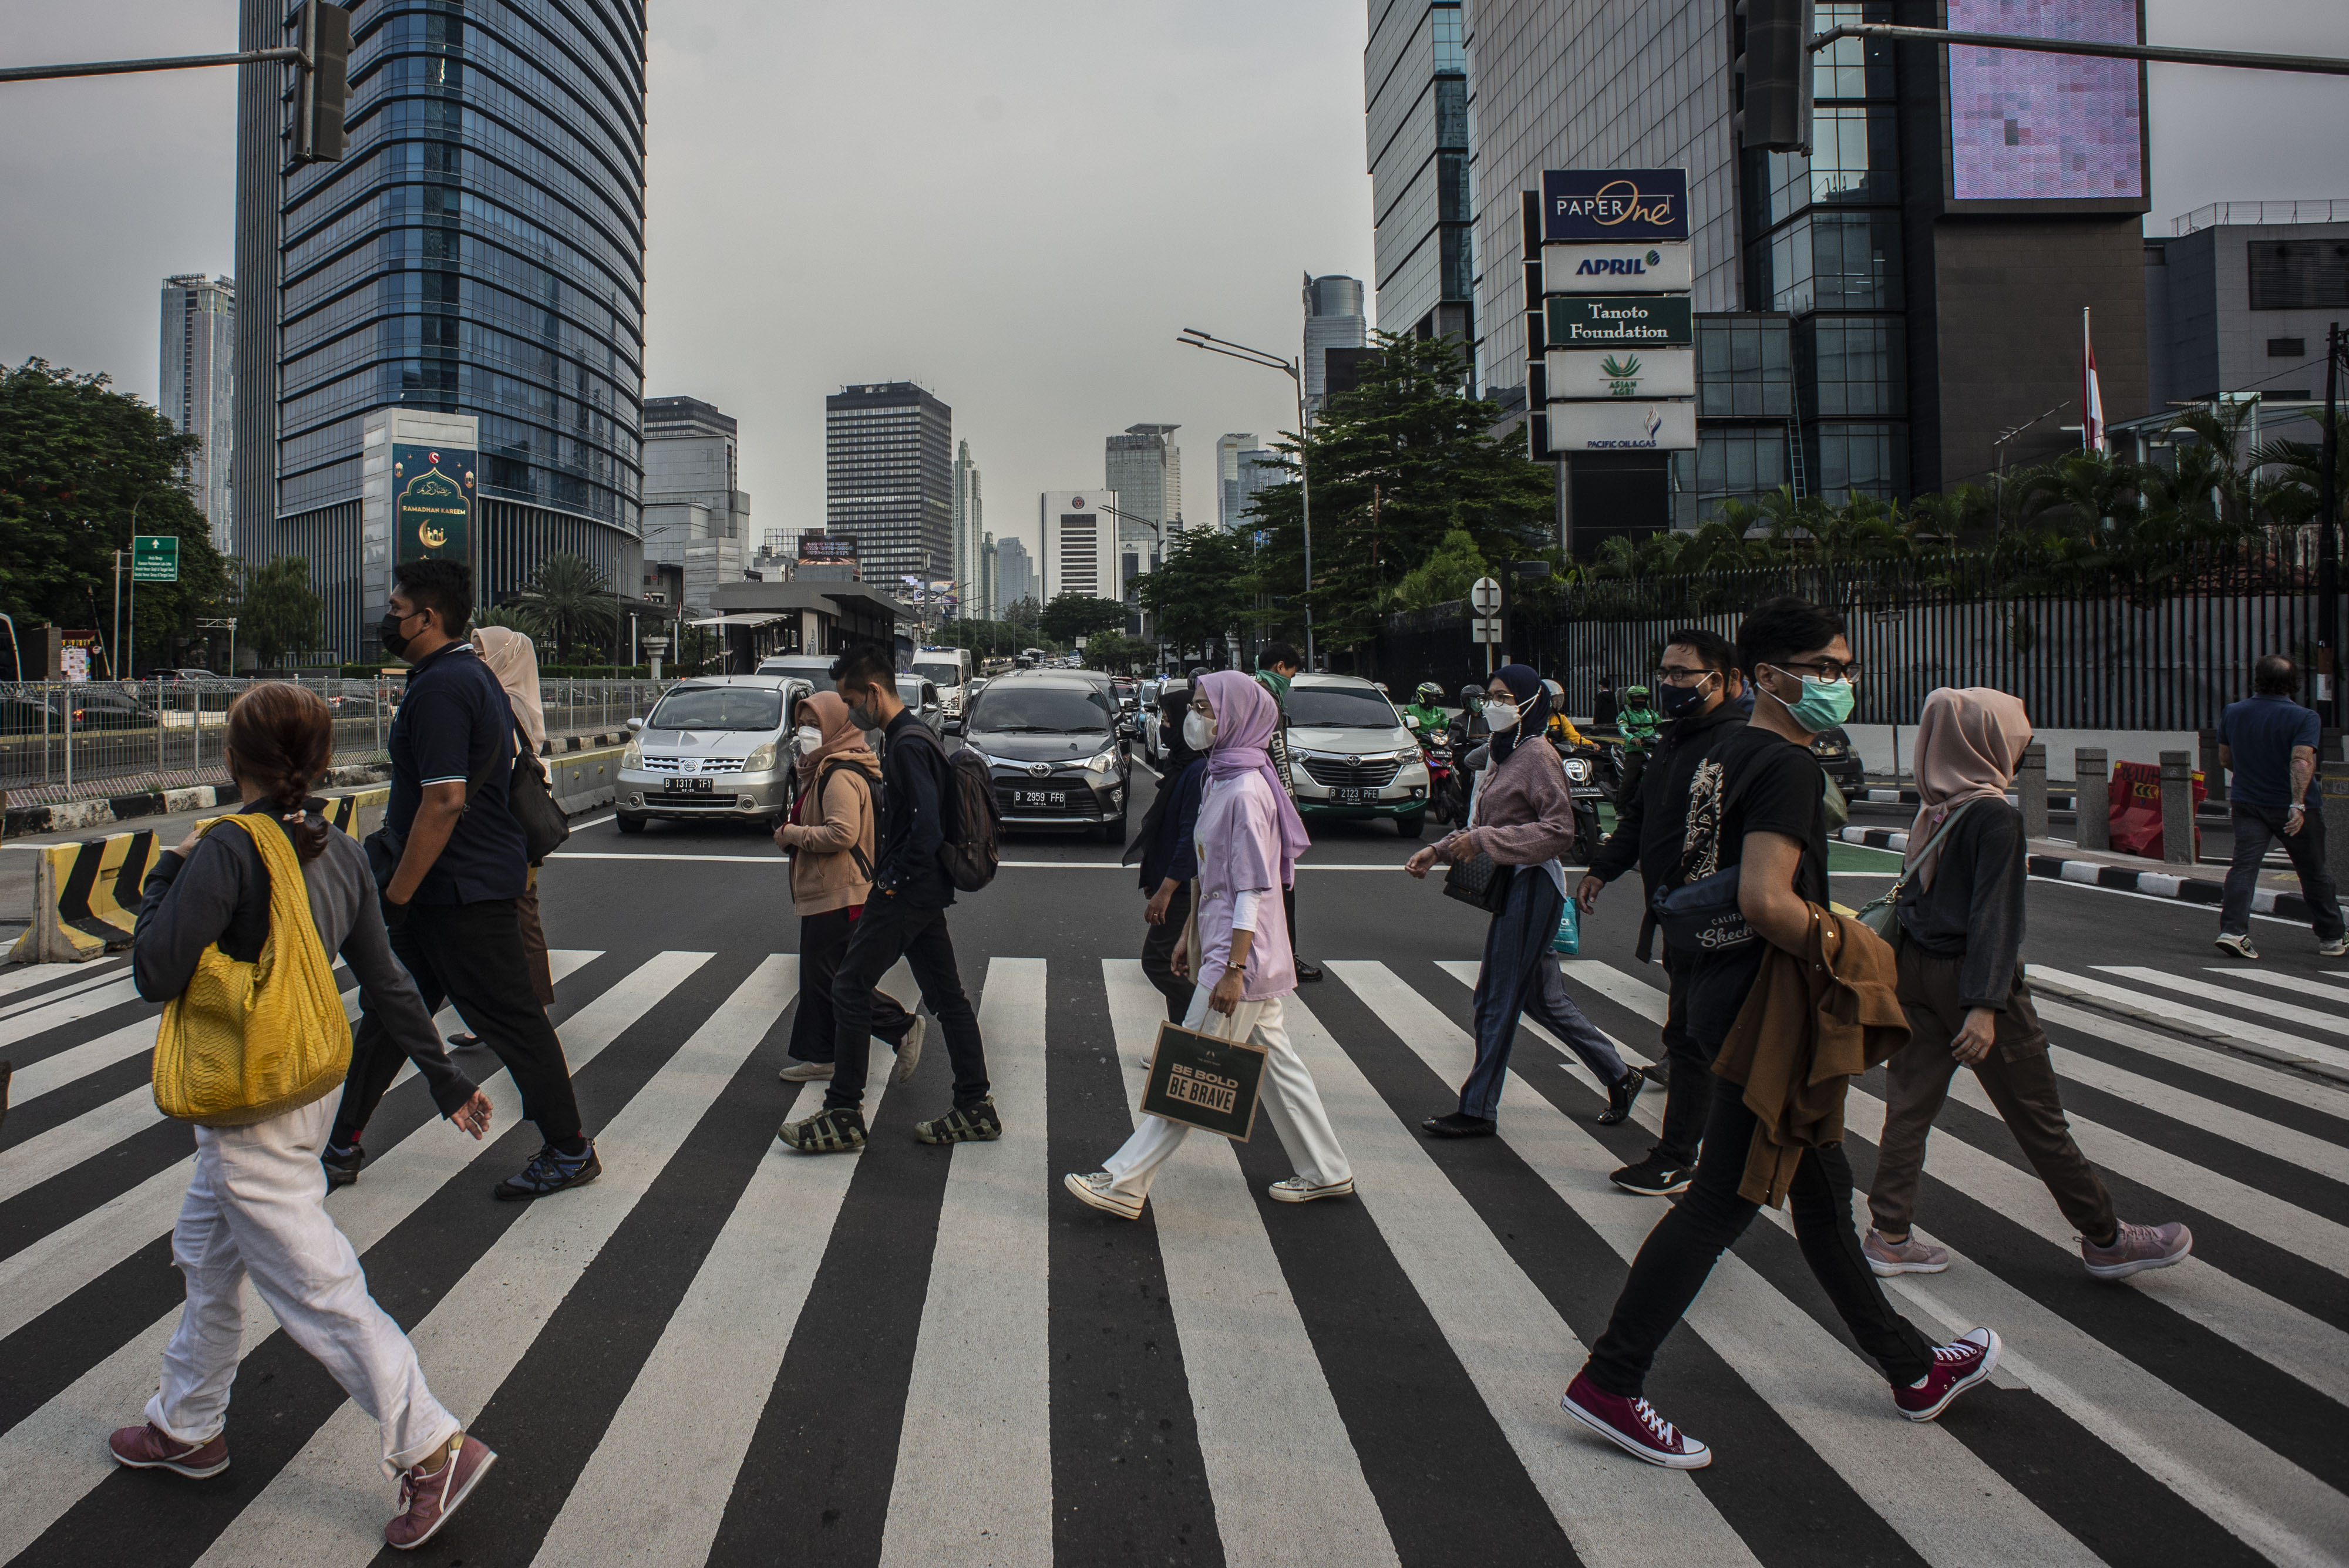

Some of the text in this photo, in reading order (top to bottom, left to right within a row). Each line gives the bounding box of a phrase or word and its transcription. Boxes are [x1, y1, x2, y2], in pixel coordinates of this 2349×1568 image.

[1557, 180, 1675, 226] PAPER One
[1576, 258, 1646, 275] APRIL
[1588, 303, 1649, 319] Tanoto
[1570, 321, 1669, 339] Foundation
[1608, 381, 1637, 389] ASIAN
[402, 505, 440, 513] RAMADHAN
[1270, 730, 1294, 798] CONVERSE
[665, 779, 712, 788] B 1317 TFY
[1015, 792, 1064, 802] B 2959 FFB
[1331, 789, 1377, 798] B 2123 PFE
[1172, 1062, 1239, 1089] BE BOLD
[1169, 1076, 1233, 1111] BE BRAVE
